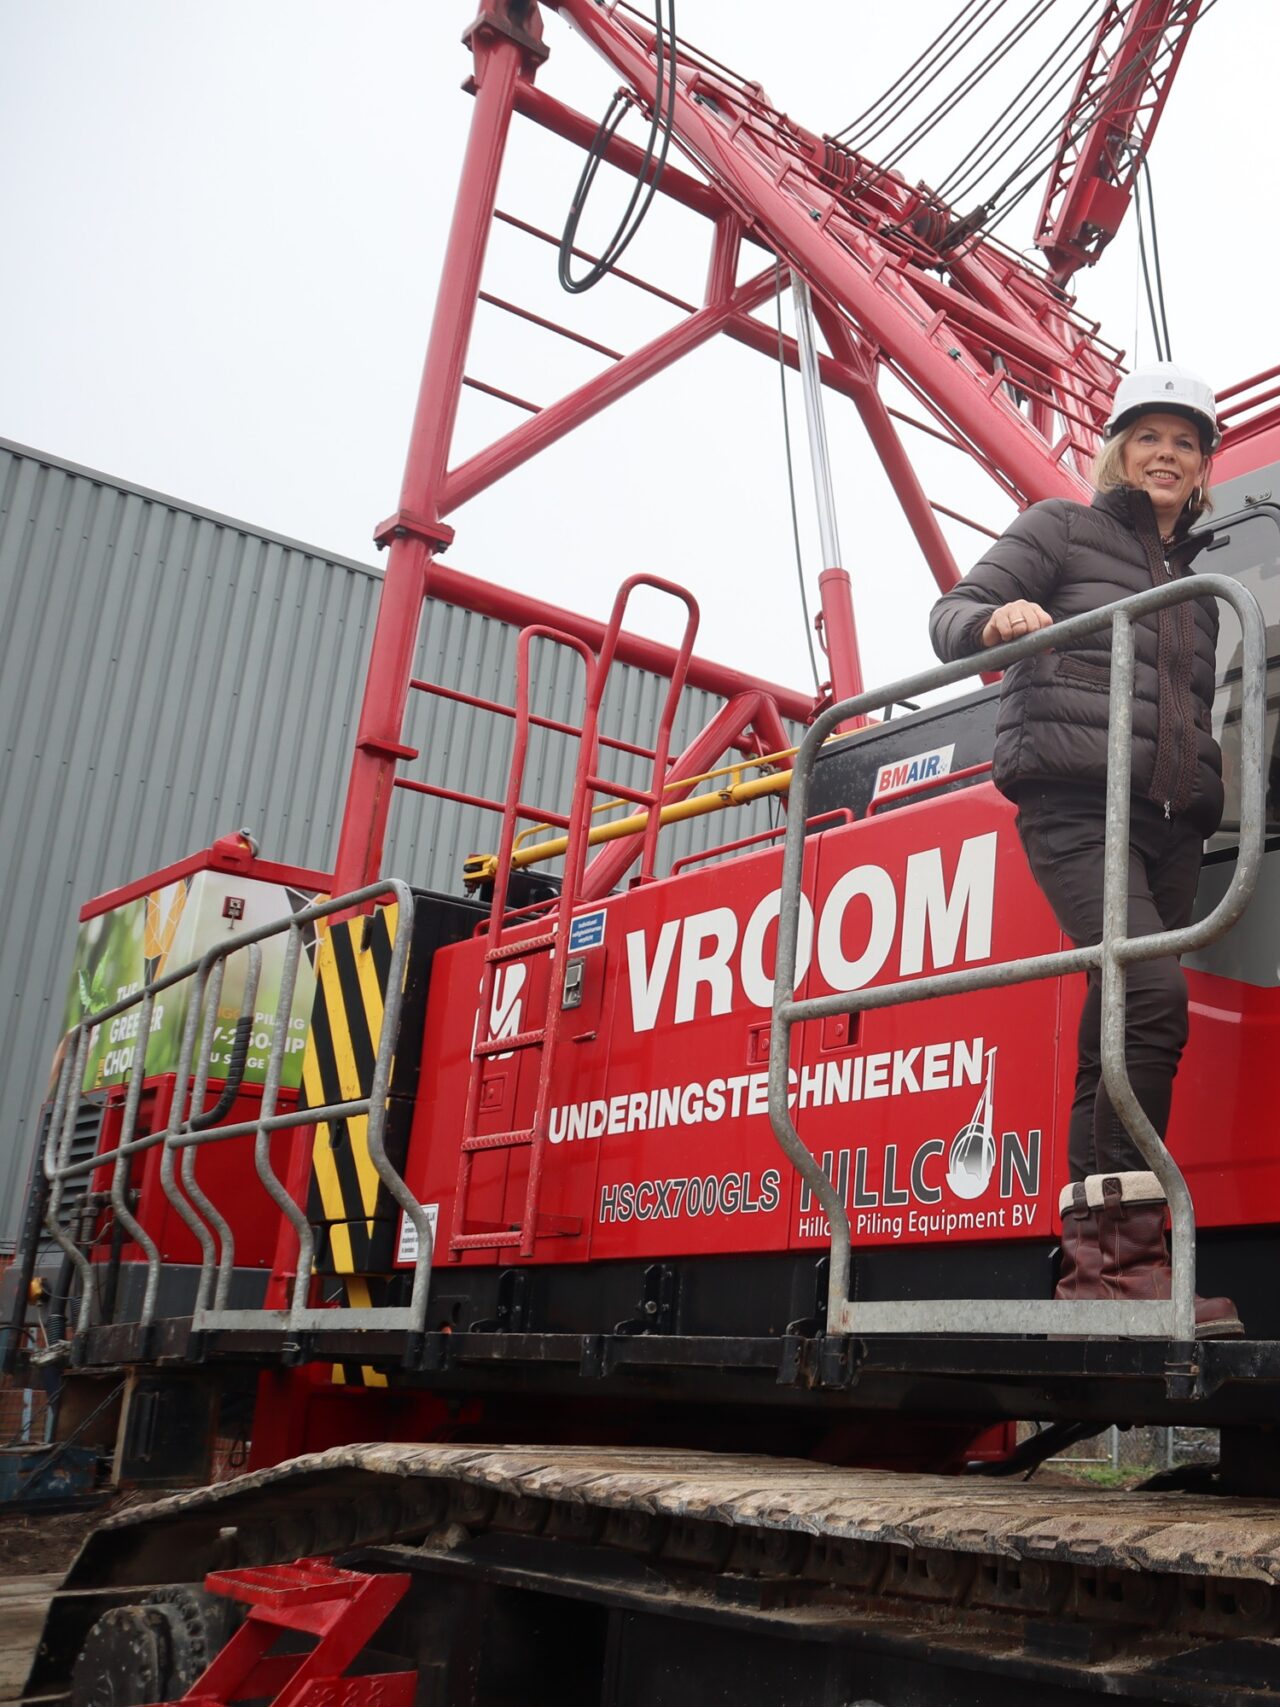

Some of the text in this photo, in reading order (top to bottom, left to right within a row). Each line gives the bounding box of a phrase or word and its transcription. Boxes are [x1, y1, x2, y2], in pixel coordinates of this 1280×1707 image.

[878, 755, 941, 792] BMAIR
[625, 831, 998, 1033] VROOM
[534, 1037, 984, 1144] UNDERINGSTEHNIEKEN
[599, 1168, 781, 1224] HSCX700GLS
[856, 1213, 902, 1239] Piling
[907, 1206, 1006, 1237] Equipment
[1011, 1203, 1037, 1226] BV
